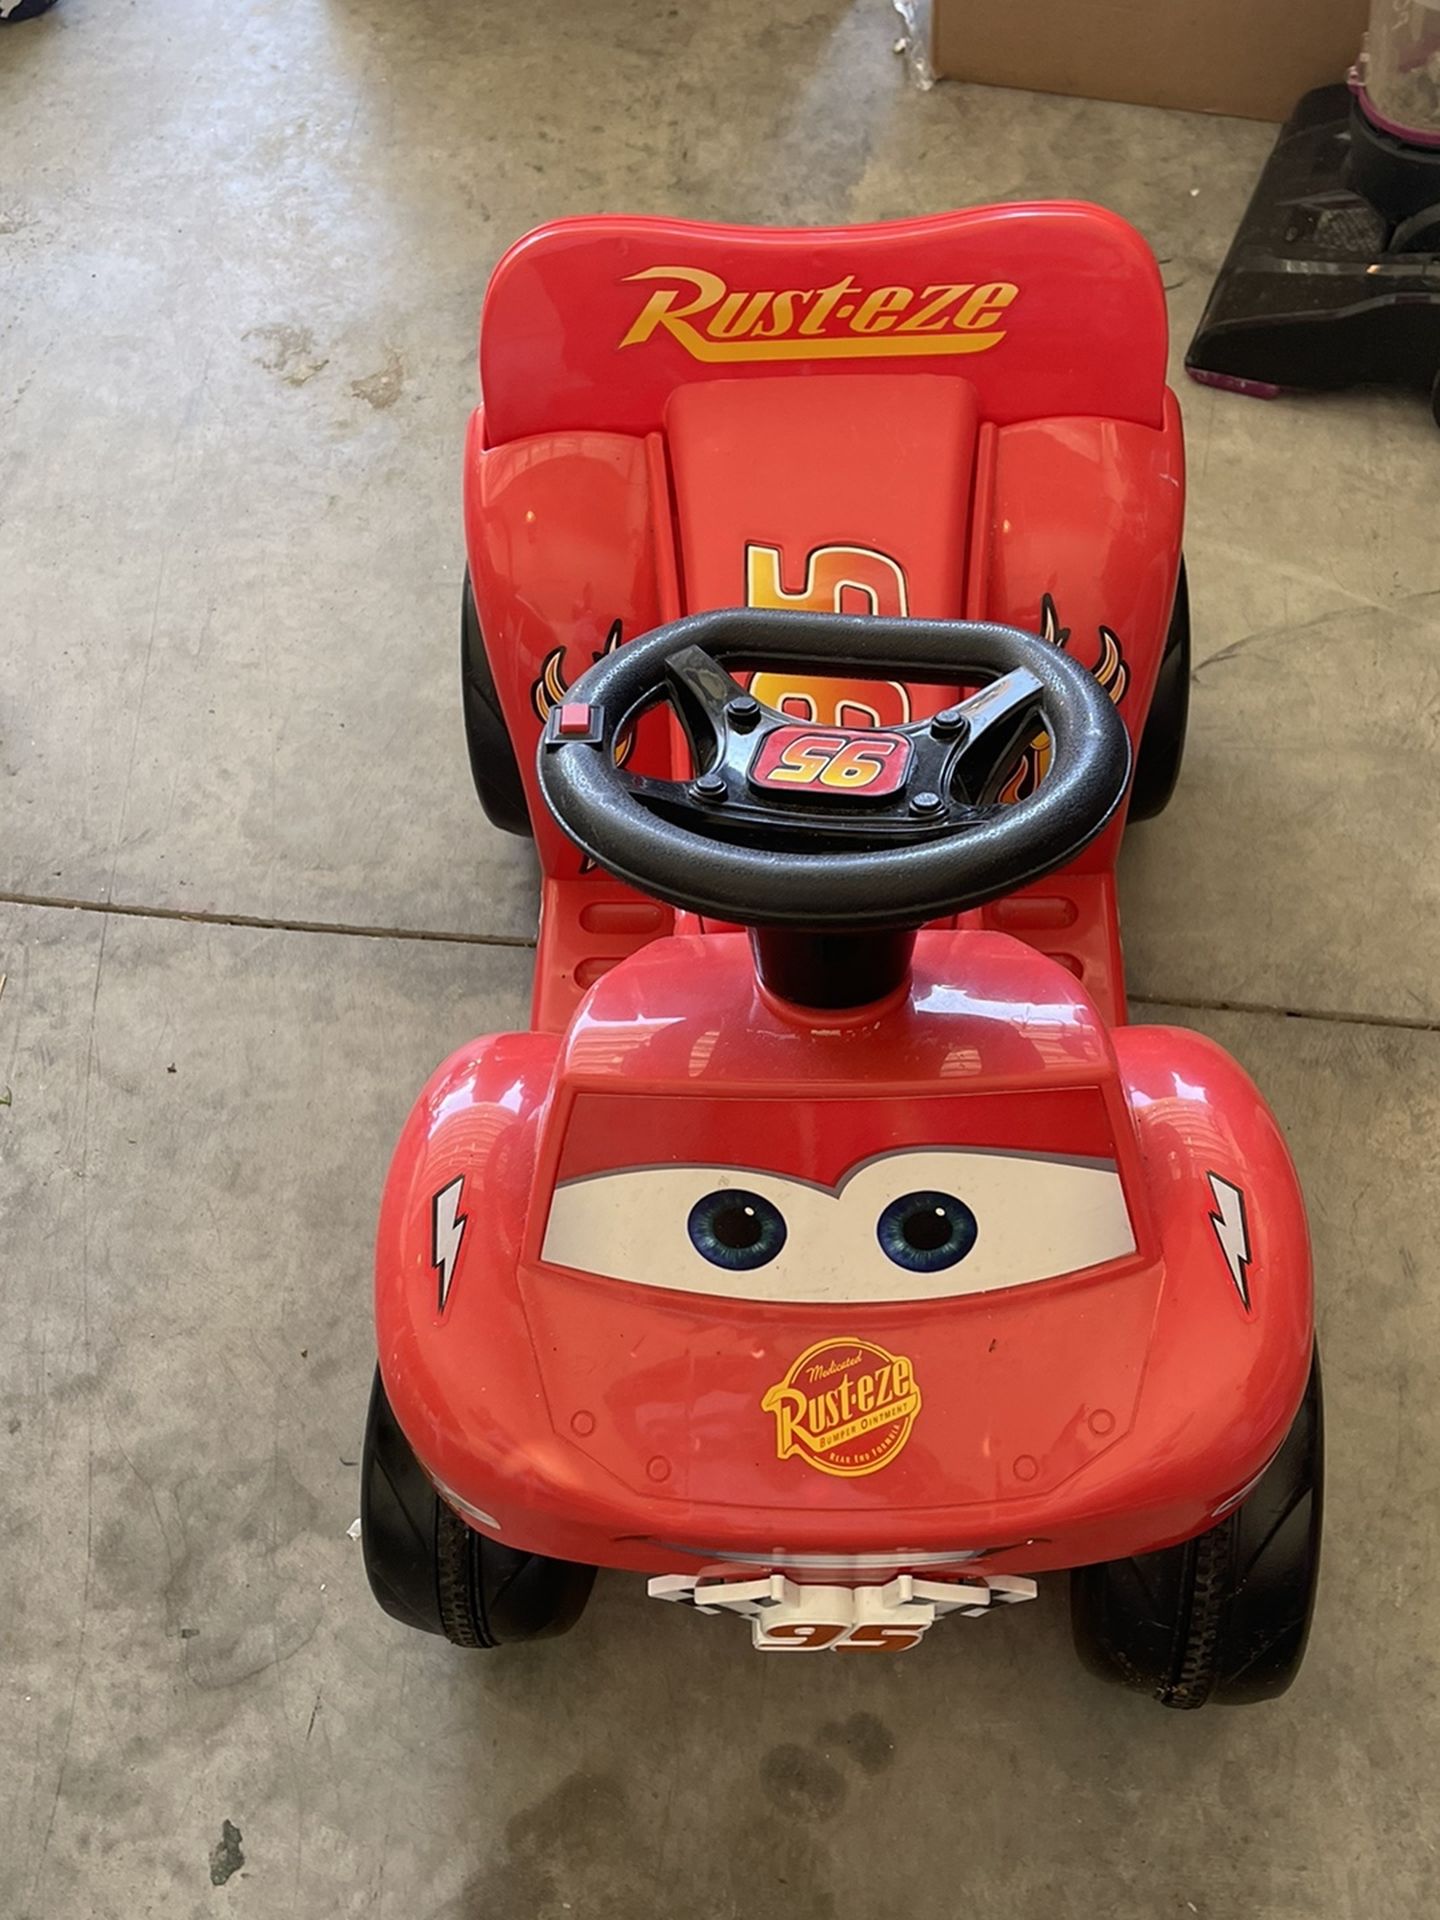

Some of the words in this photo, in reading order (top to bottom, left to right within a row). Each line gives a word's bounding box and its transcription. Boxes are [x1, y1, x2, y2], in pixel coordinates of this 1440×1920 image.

[767, 735, 898, 789] 95
[805, 1349, 863, 1384] Medicated
[860, 1402, 909, 1430] OINTMENT
[753, 1620, 932, 1652] 95
